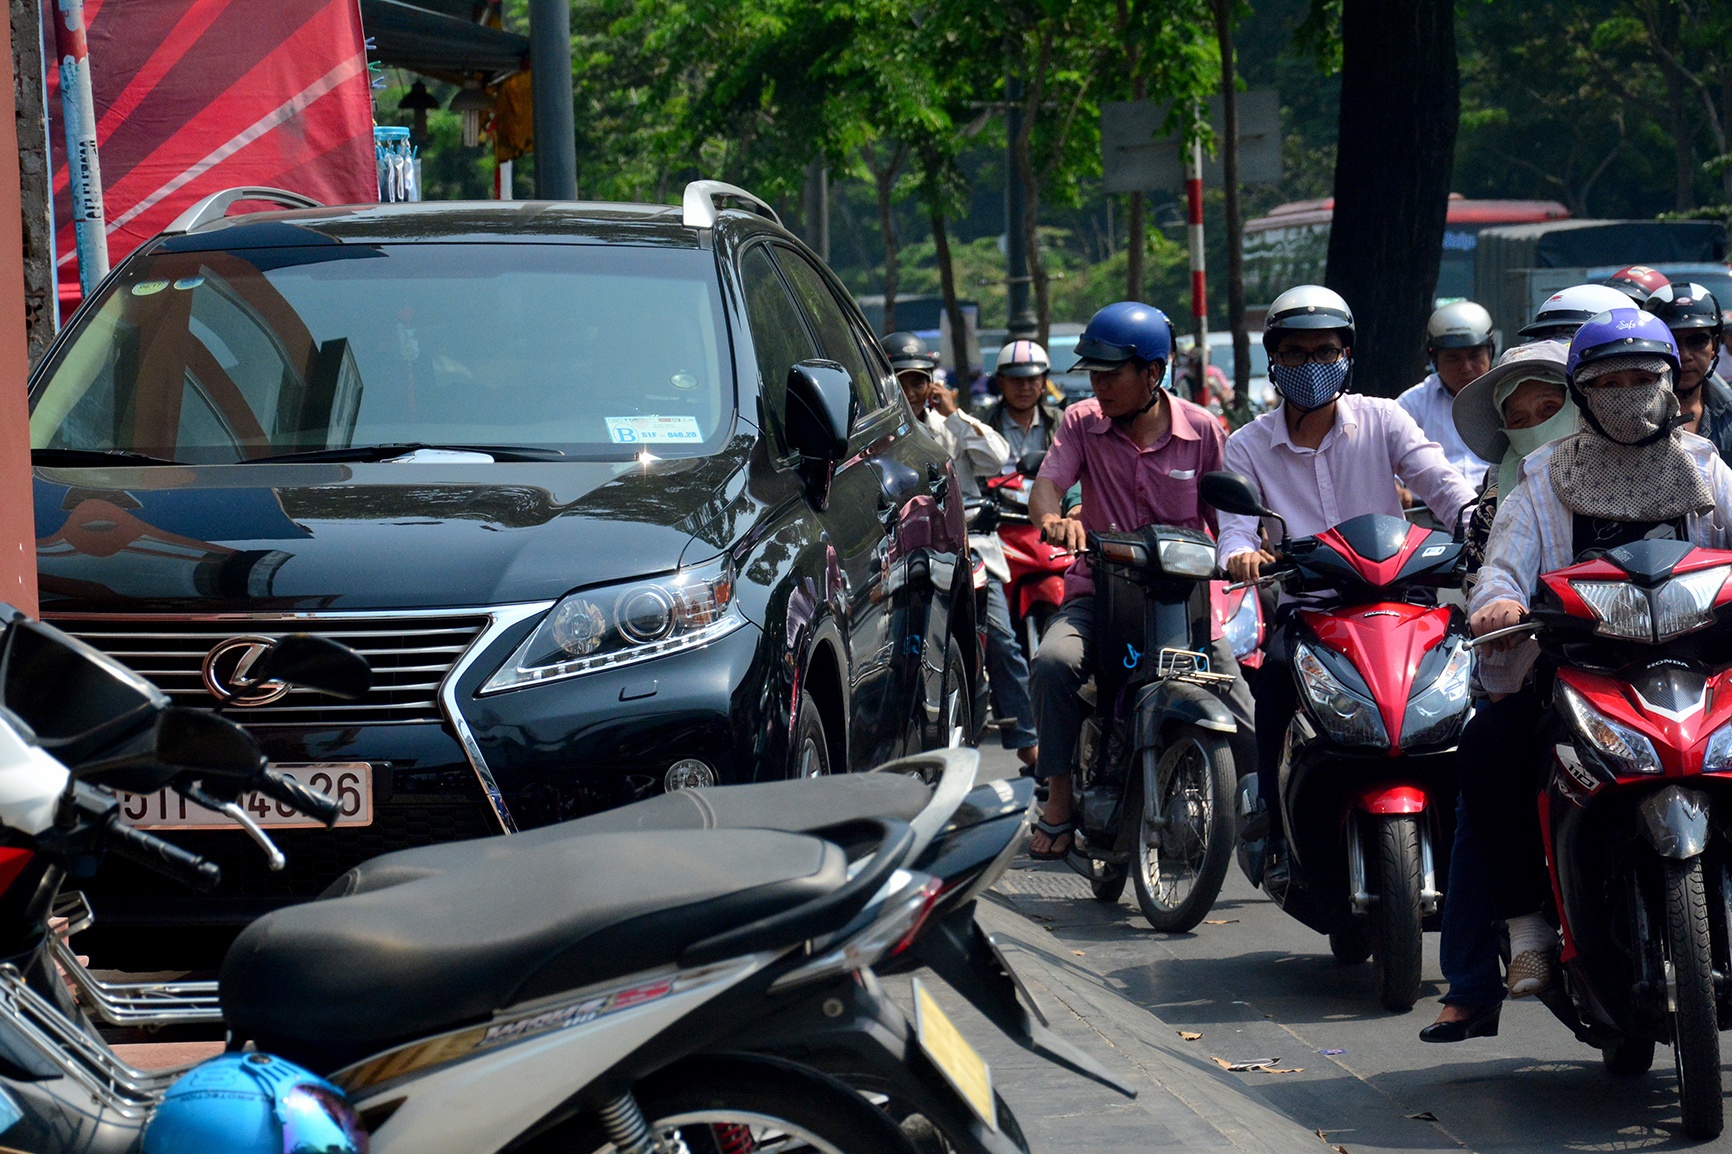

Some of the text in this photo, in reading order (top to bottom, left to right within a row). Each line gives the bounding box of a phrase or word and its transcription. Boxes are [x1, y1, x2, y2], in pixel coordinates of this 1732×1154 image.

[1615, 320, 1636, 330] Safe
[615, 427, 637, 442] B
[1646, 659, 1690, 669] HONDA
